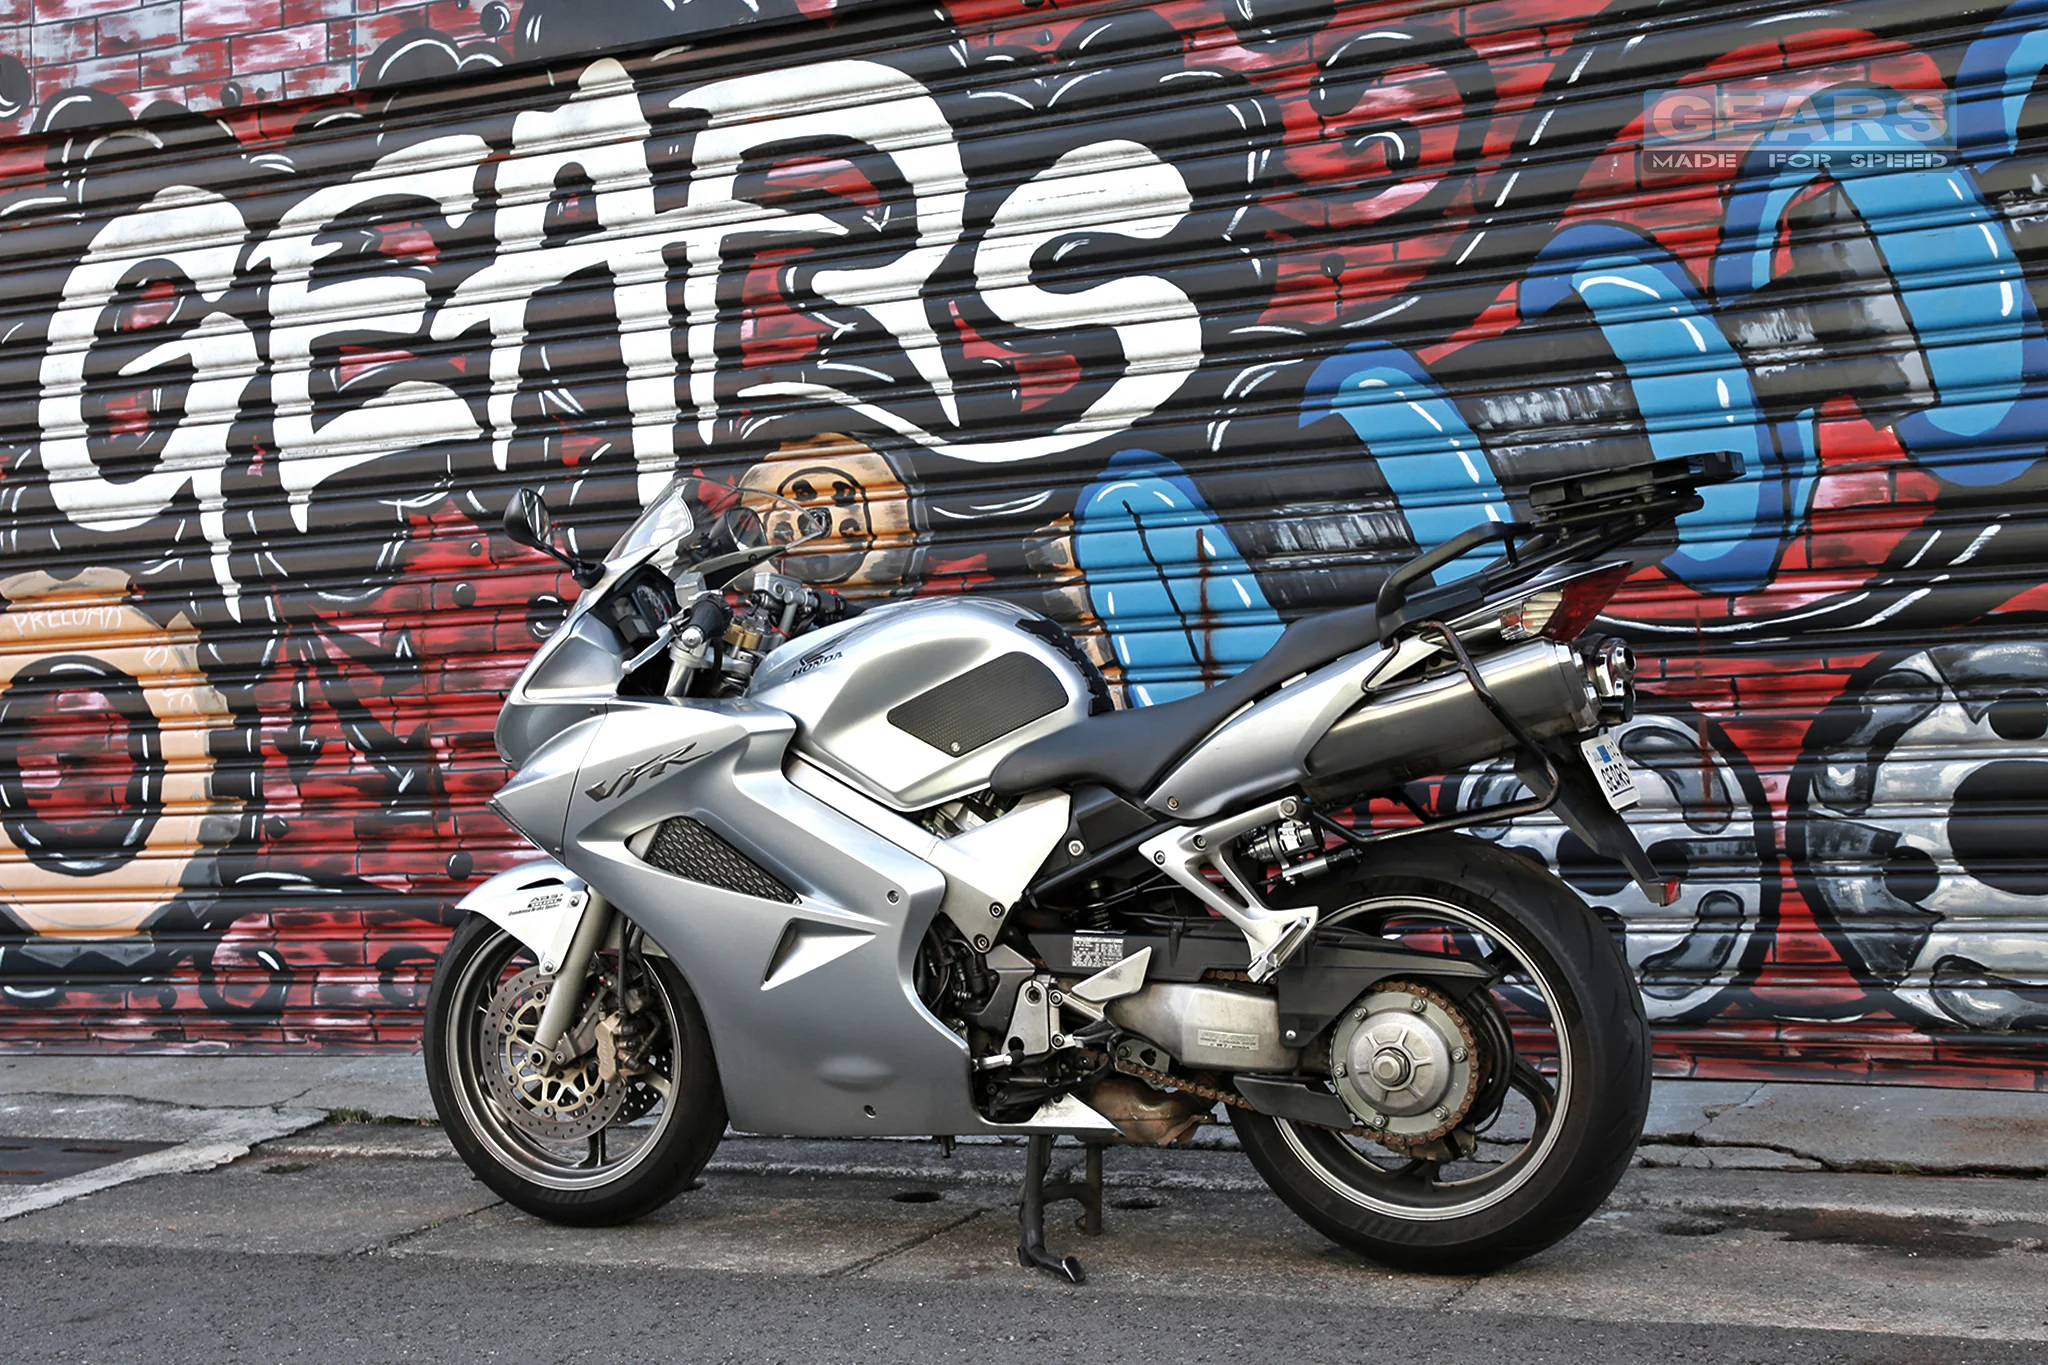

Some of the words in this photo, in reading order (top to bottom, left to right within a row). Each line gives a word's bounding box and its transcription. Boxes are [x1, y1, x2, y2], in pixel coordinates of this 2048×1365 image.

[38, 57, 1203, 622] GEARS
[791, 650, 843, 678] HONDA
[585, 741, 713, 802] VFR
